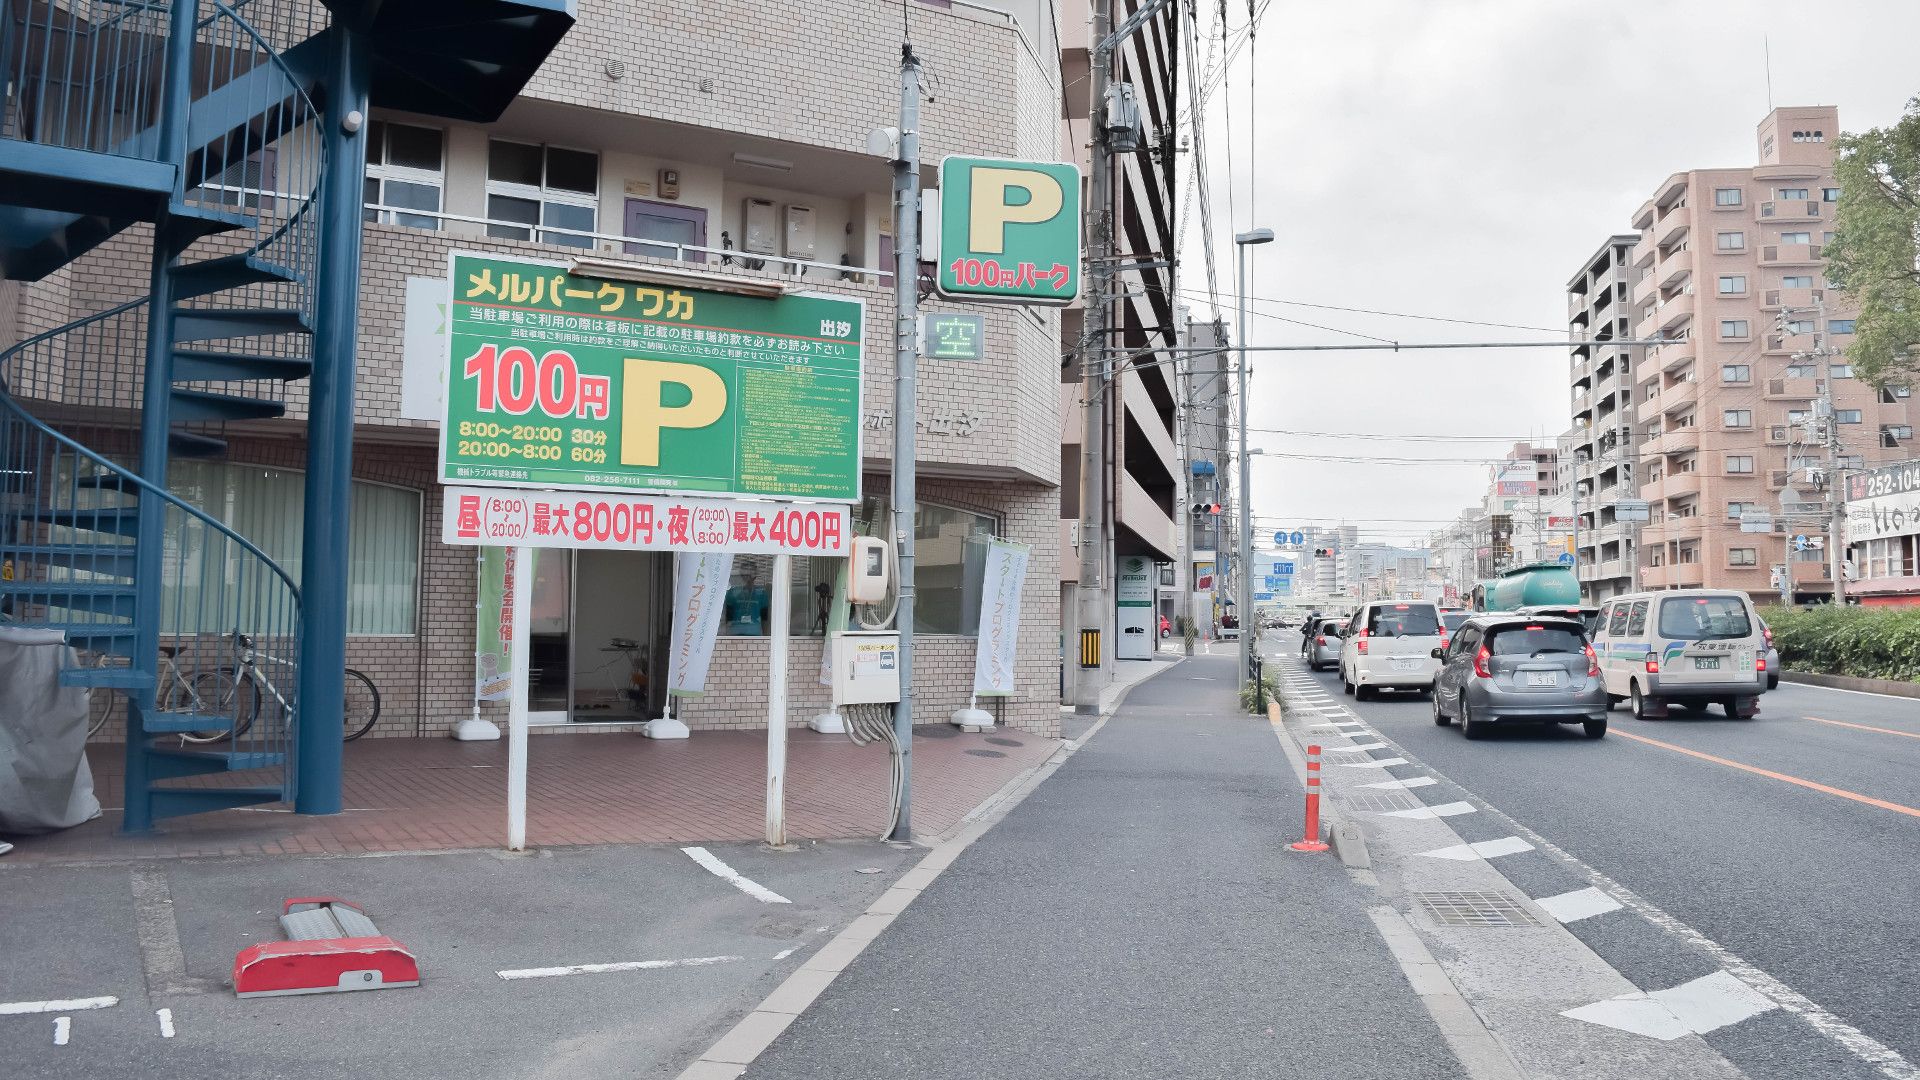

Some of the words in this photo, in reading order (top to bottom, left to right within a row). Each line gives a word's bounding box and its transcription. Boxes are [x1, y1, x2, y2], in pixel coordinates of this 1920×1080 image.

[969, 166, 1064, 254] P
[467, 268, 625, 312] メルパーク
[636, 288, 694, 320] ワカ
[951, 258, 1070, 290] 100円パーク
[820, 319, 851, 338] 出汐
[935, 318, 976, 356] 空
[464, 343, 610, 420] 100円
[459, 421, 562, 442] 8:00～20:00
[571, 428, 607, 447] 30分
[621, 358, 727, 467] P
[458, 441, 562, 462] 20:00～8:00
[571, 447, 607, 464] 60分
[457, 495, 481, 537] 昼
[733, 510, 840, 550] 最大400円
[678, 552, 705, 687] ートプログラミング
[992, 552, 1012, 688] スタートプログラミング
